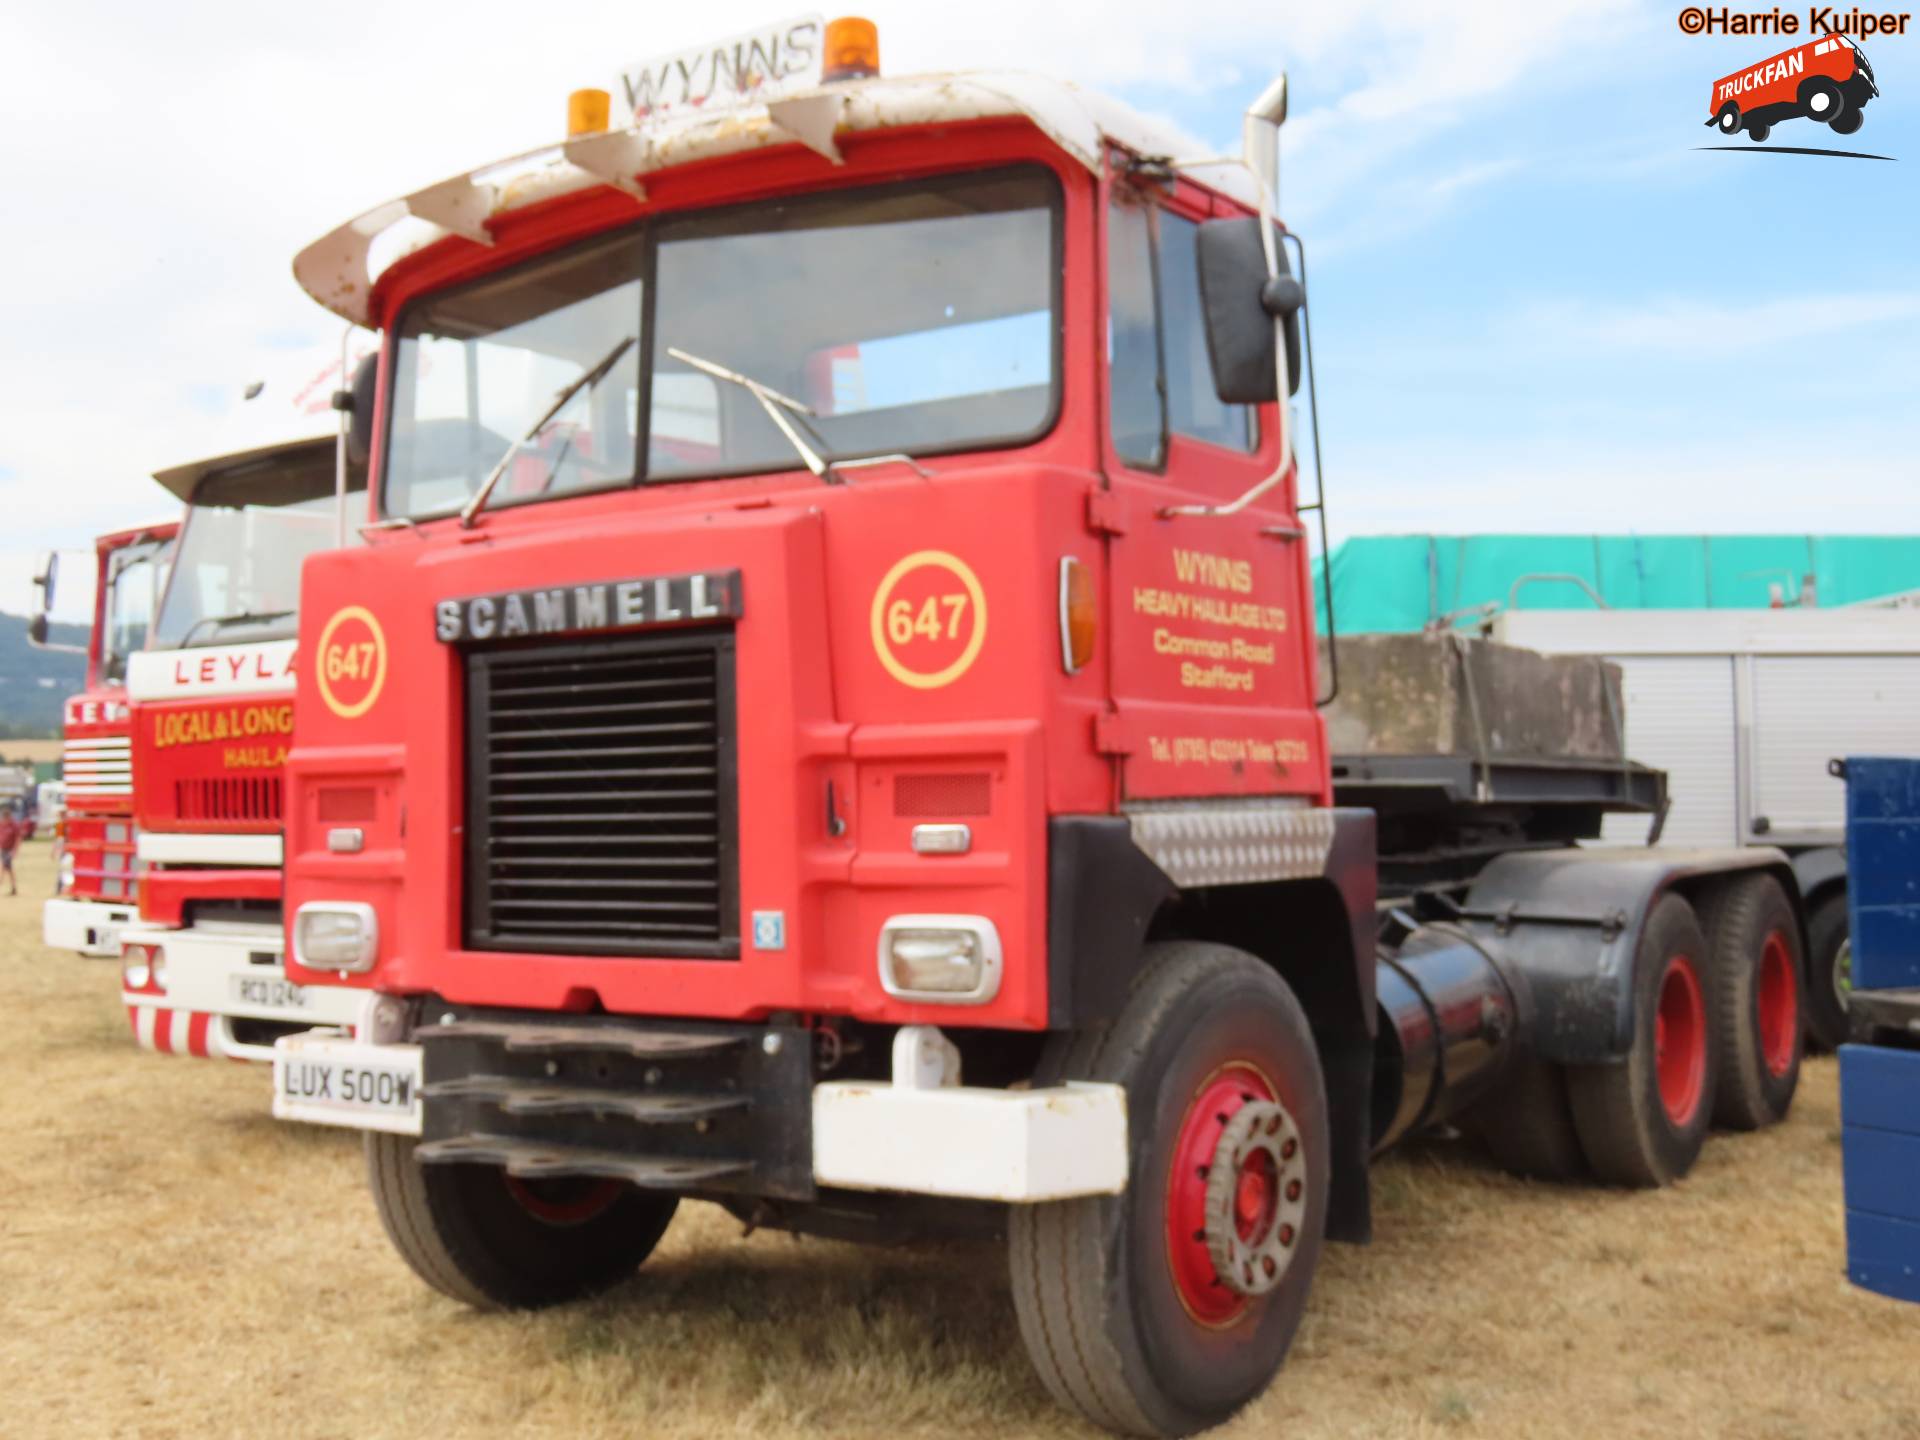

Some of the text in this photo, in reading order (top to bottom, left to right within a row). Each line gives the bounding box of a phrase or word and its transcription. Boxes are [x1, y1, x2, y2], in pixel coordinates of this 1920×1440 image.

[621, 22, 817, 111] WYNNS
[1173, 548, 1253, 593] WYNNS
[436, 575, 719, 641] SCAMMELL
[888, 594, 967, 644] 647
[1133, 587, 1190, 618] HEAVY
[327, 642, 376, 681] 647
[1154, 628, 1275, 664] Common Road
[1180, 662, 1254, 691] Stafford
[285, 1064, 332, 1099] LUX
